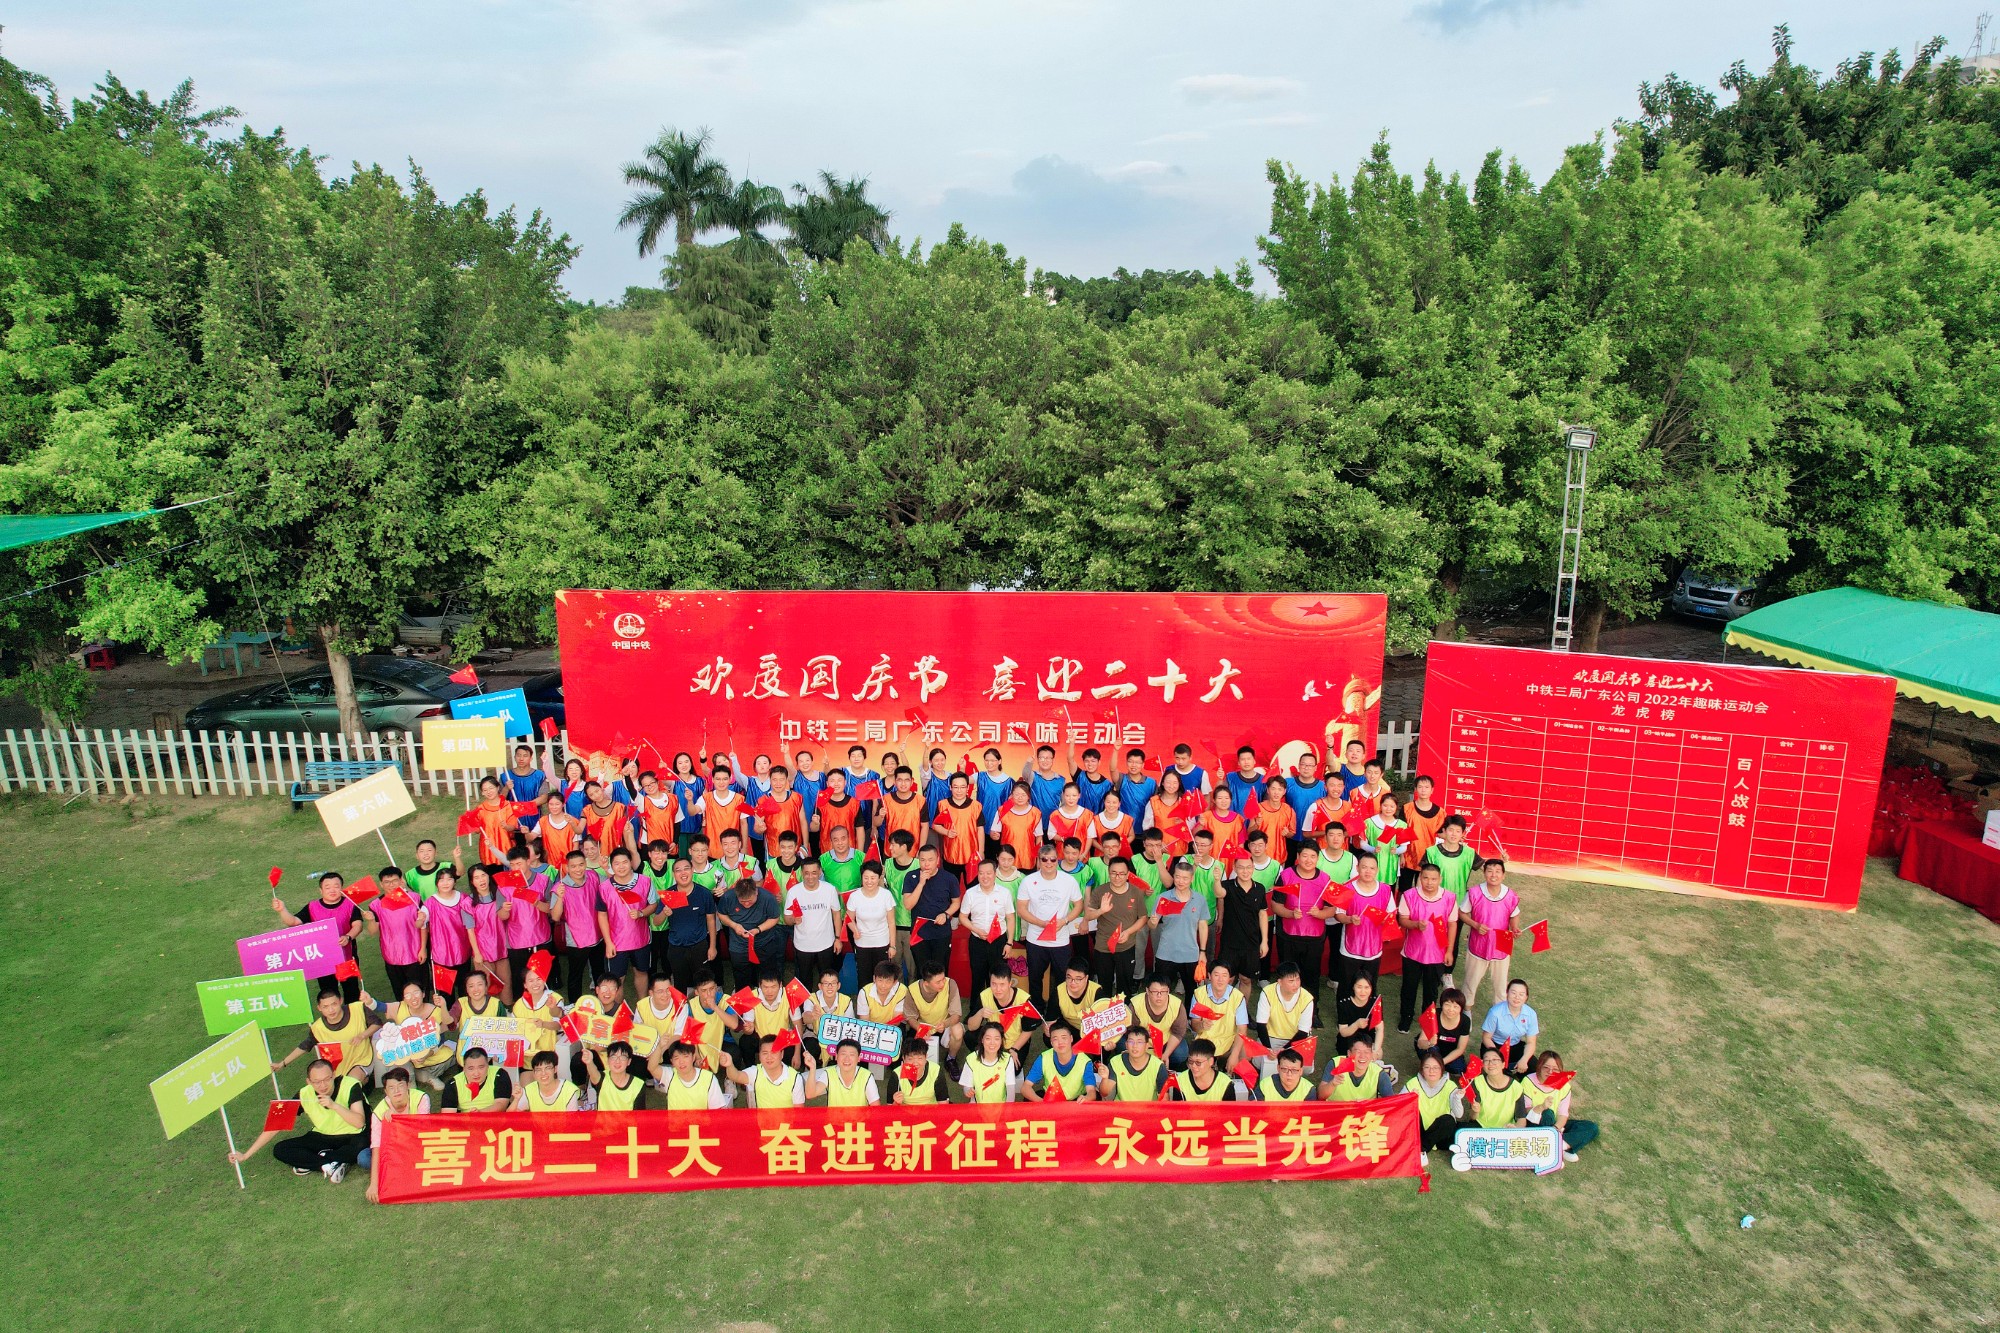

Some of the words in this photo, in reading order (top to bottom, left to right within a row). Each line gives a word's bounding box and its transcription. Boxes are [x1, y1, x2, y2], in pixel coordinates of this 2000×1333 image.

[612, 640, 651, 650] 中国中铁
[690, 652, 949, 703] 欢度国庆节
[982, 655, 1244, 703] 喜迎二十大
[1573, 669, 1642, 688] 欢度国庆节
[1644, 673, 1714, 692] 喜迎二十大
[1526, 683, 1641, 704] 中铁三局广东公司
[1644, 693, 1769, 714] 2022年趣味运动会
[442, 737, 489, 753] 第四队
[780, 719, 1146, 745] 中铁三局广东公司趣味运动会
[342, 790, 393, 823] 第六队
[1728, 758, 1752, 828] 百人战鼓
[264, 943, 324, 970] 第八队
[225, 992, 288, 1015] 第五队
[472, 1018, 518, 1032] 王者归来
[1084, 1005, 1127, 1033] 勇夺冠军
[184, 1056, 247, 1105] 第七队
[415, 1124, 722, 1187] 喜迎二十大
[760, 1119, 1060, 1175] 奋进新征程
[1097, 1110, 1391, 1169] 永远当先锋
[1467, 1136, 1551, 1159] 横扫赛场
